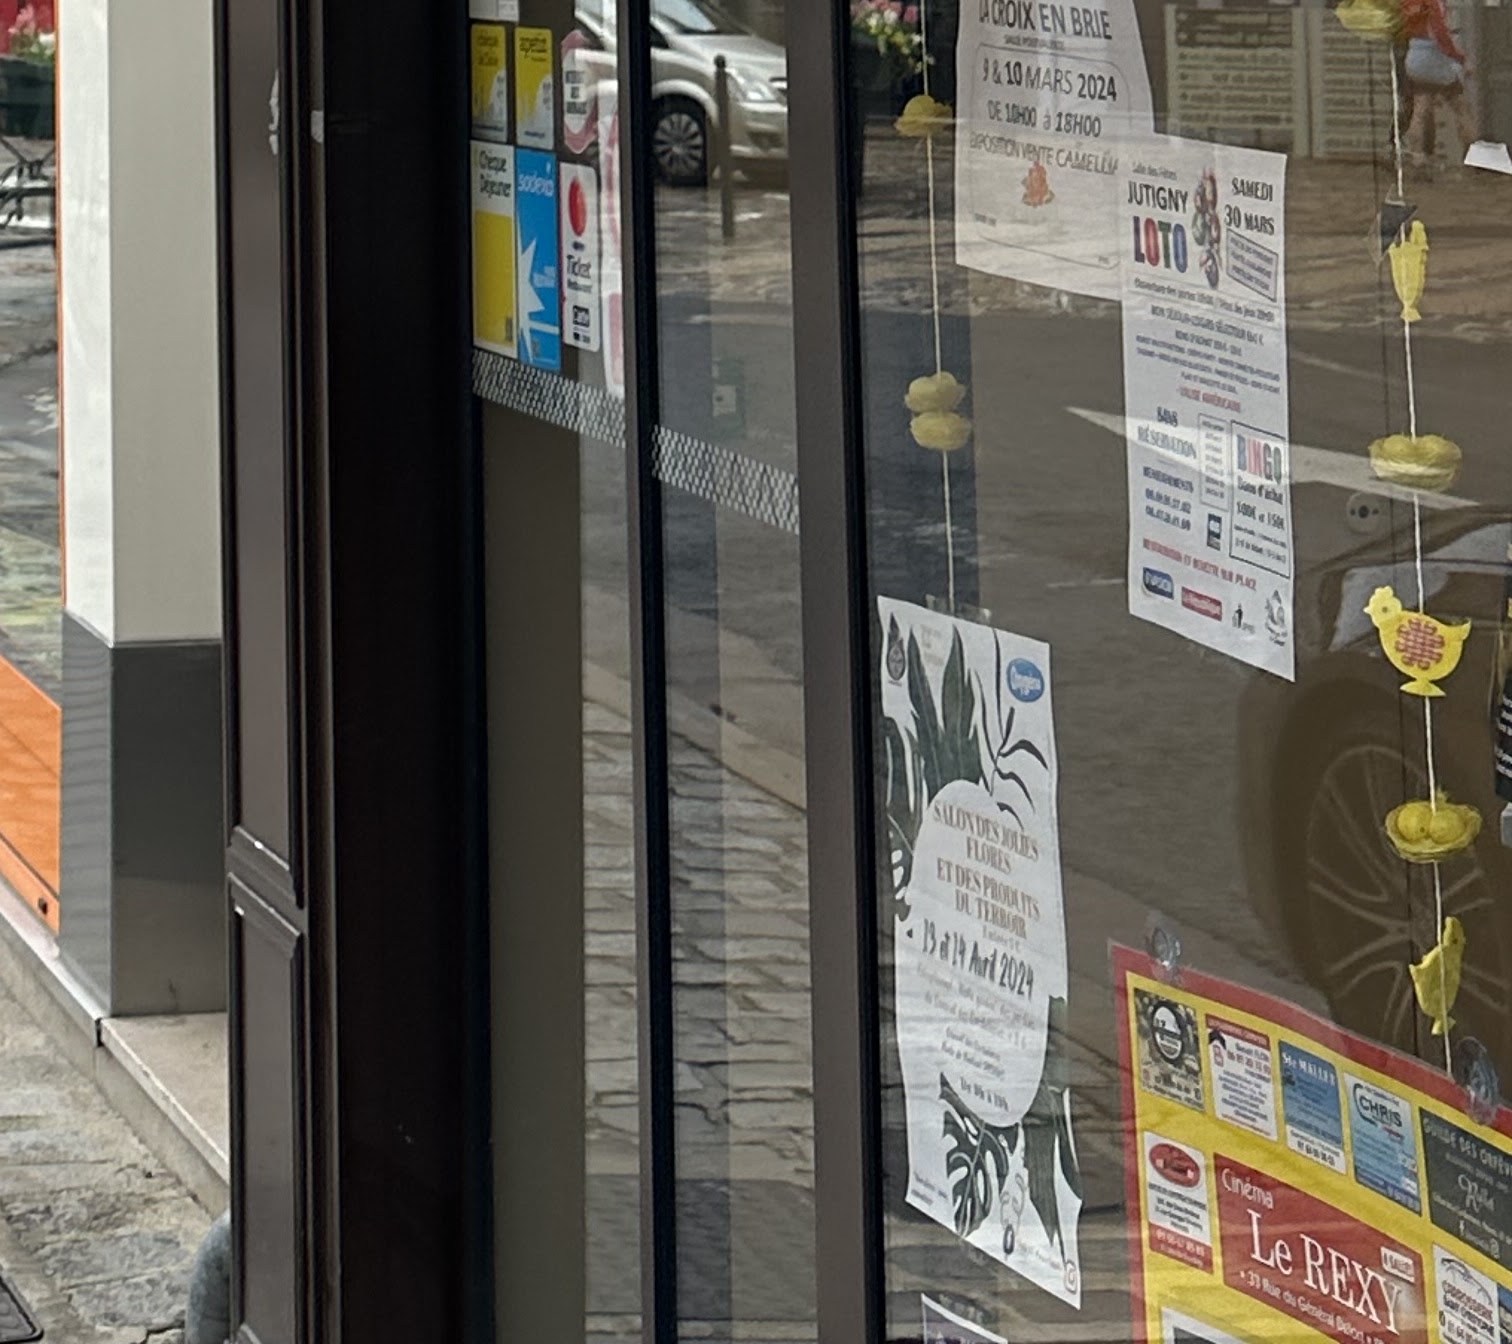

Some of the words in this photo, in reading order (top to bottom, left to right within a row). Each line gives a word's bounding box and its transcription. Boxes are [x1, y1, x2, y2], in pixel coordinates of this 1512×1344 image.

[1039, 3, 1066, 34] EN
[1070, 6, 1113, 40] BRIE
[1004, 61, 1023, 86] 10
[1025, 65, 1073, 95] MARS
[1077, 72, 1117, 102] 2024
[1055, 111, 1101, 138] 18H00
[1128, 180, 1188, 214] JUTIGNY
[1231, 177, 1273, 202] SAMEDI
[1224, 204, 1241, 229] 30
[1244, 211, 1275, 235] MARS
[1133, 216, 1188, 273] LOTO
[1237, 434, 1282, 485] BINGO
[933, 801, 974, 835] SALON
[975, 815, 999, 844] DES
[937, 857, 953, 883] ET
[955, 864, 981, 894] DES
[955, 888, 972, 915] DU
[922, 918, 936, 955] 13
[999, 952, 1034, 1002] 2024
[1359, 1095, 1403, 1128] CHRIS
[1221, 1168, 1274, 1210] Cinéma
[1247, 1209, 1293, 1276] Le
[1299, 1233, 1402, 1336] REXY
[1262, 1278, 1281, 1299] Rue
